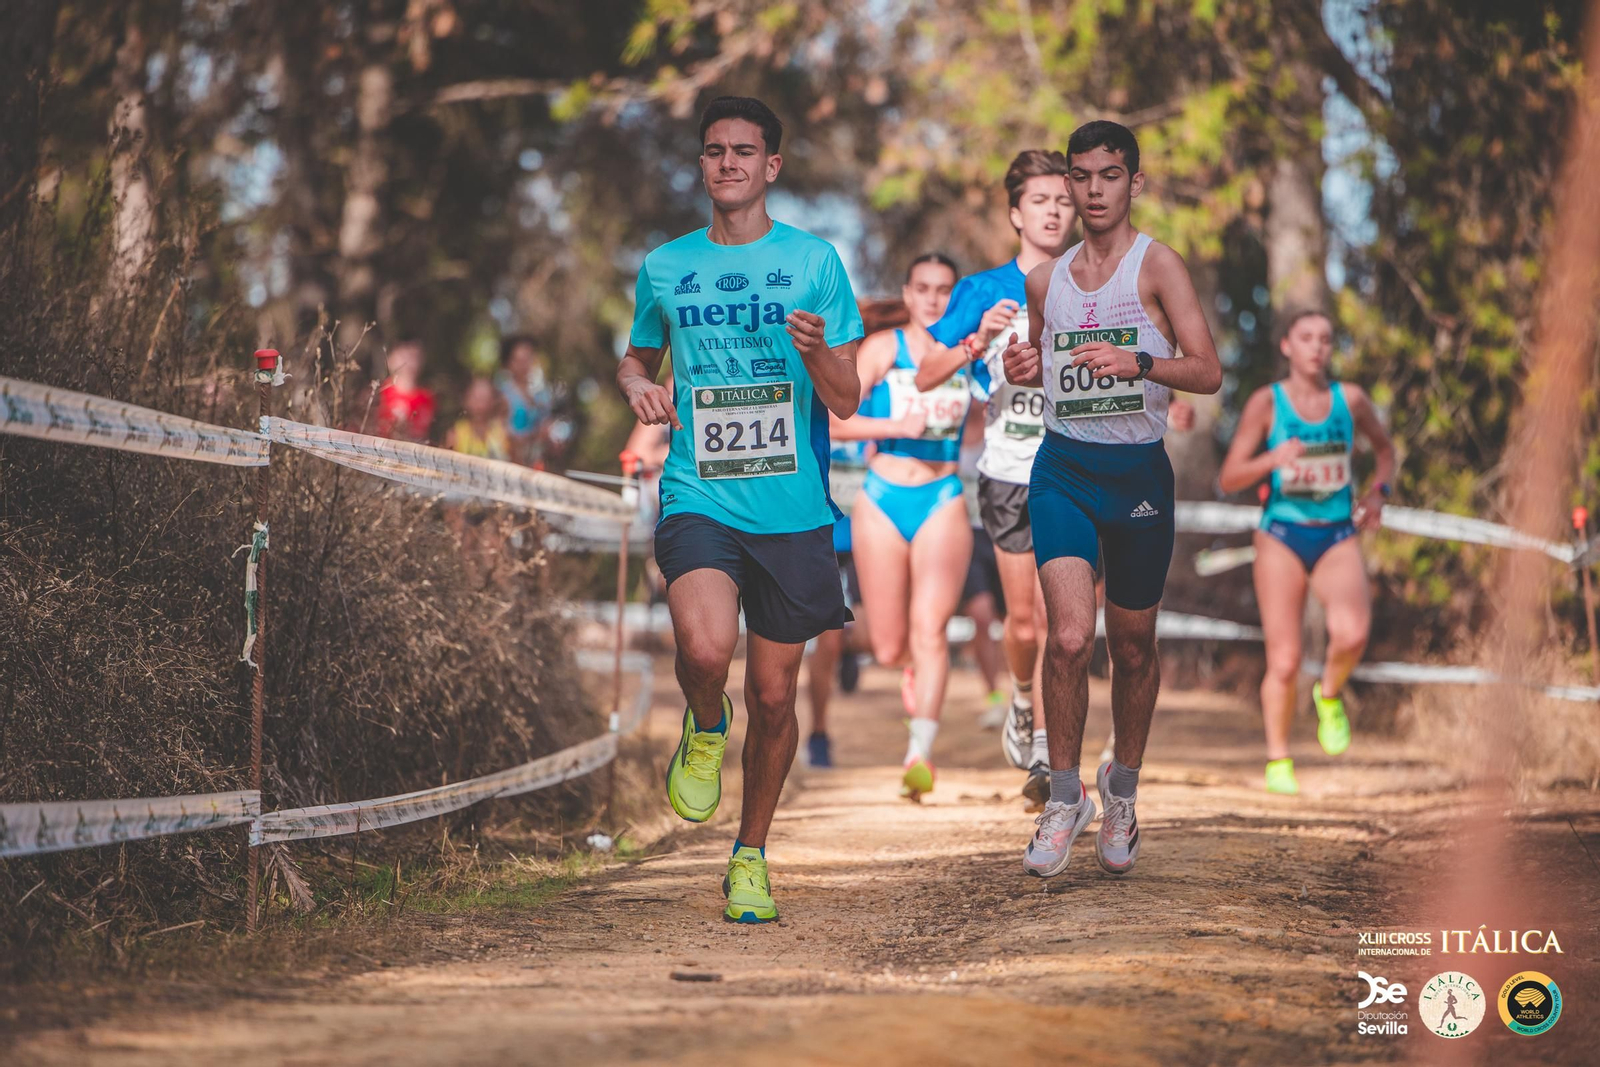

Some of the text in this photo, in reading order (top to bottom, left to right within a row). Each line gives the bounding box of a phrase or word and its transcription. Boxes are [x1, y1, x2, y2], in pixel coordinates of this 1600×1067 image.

[675, 283, 701, 291] CUEVA
[717, 277, 748, 289] TROPS
[676, 294, 787, 333] nerja
[698, 336, 773, 350] ATLETISMO
[1074, 331, 1116, 344] ITÁLICA
[721, 388, 768, 401] ITÁLICA
[704, 417, 789, 453] 8214
[1130, 510, 1159, 518] adidas
